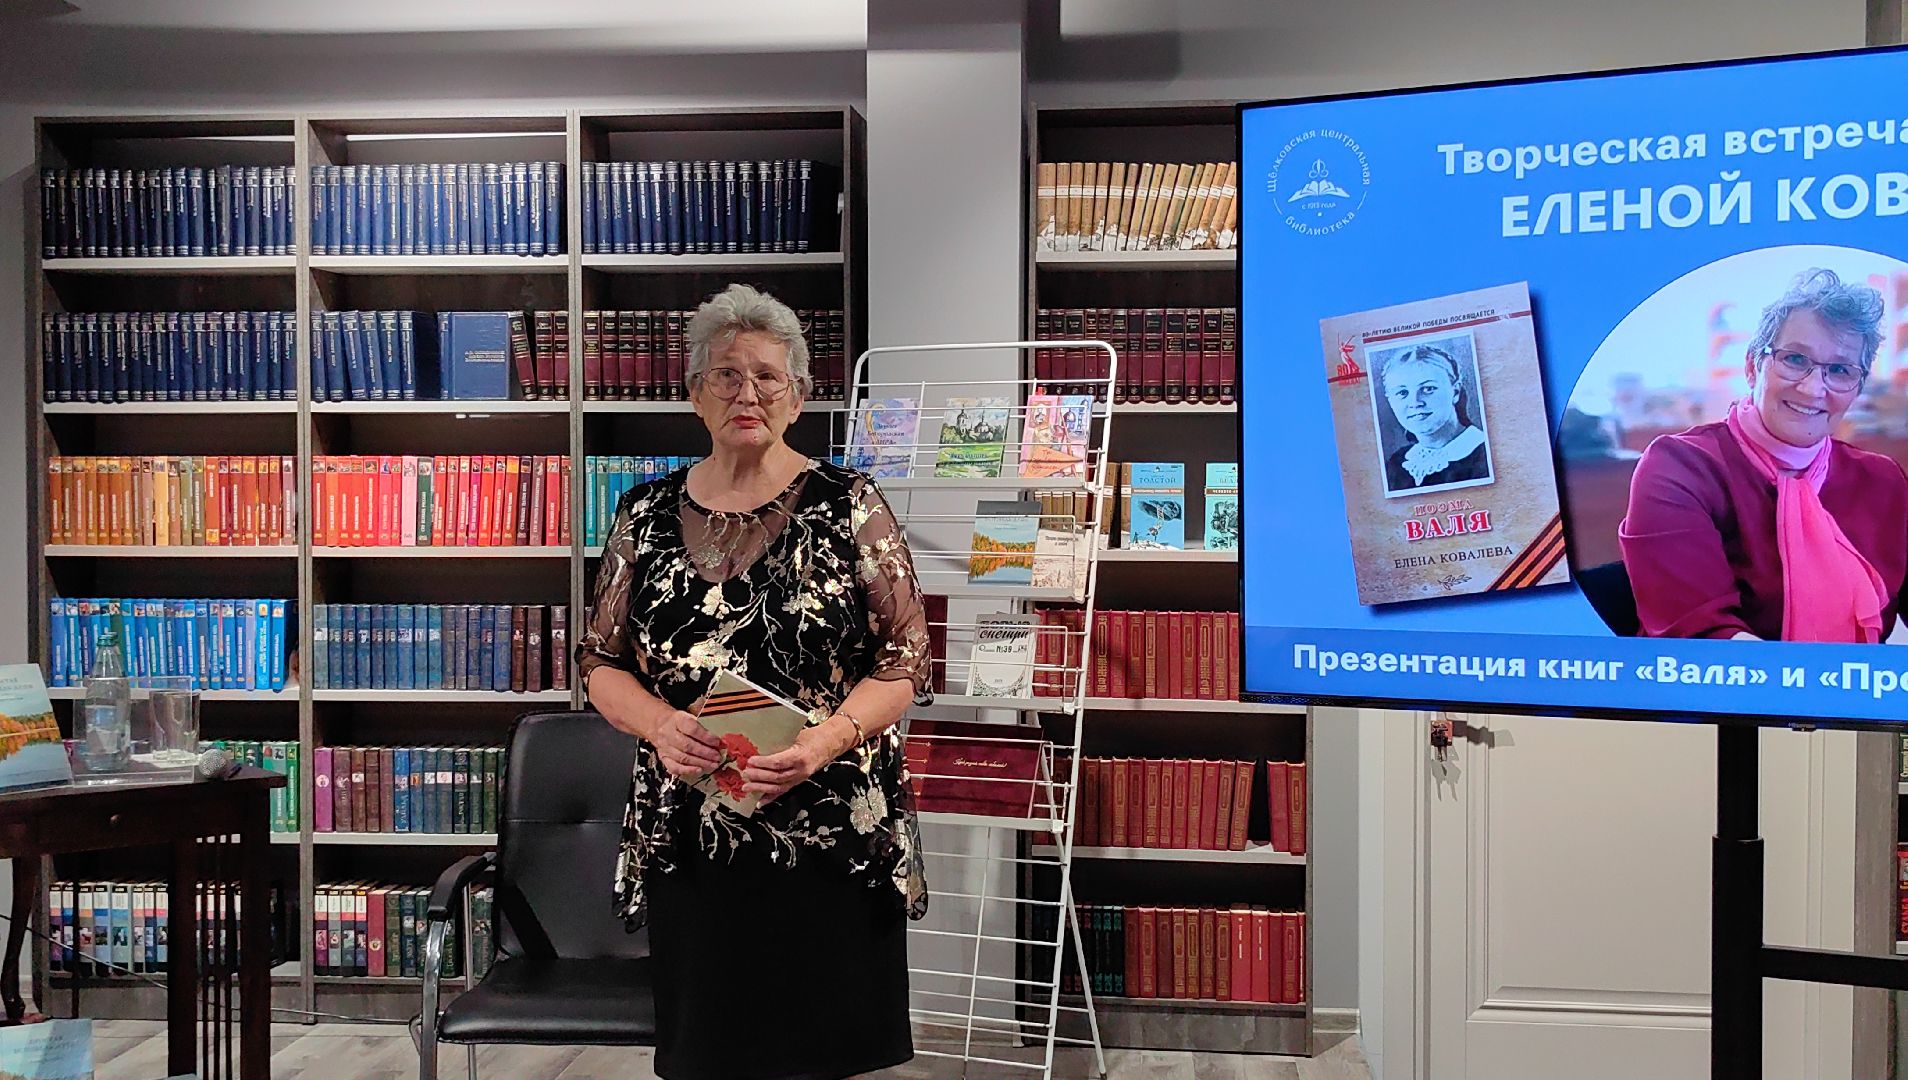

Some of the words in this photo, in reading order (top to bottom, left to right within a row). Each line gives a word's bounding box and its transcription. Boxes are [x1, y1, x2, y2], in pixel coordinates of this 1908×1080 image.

[1267, 129, 1316, 192] Щёлковская
[1321, 128, 1371, 185] центральная
[1438, 133, 1706, 178] Творческая
[1502, 171, 1752, 237] ЕЛЕНОЙ
[1777, 173, 1908, 222] КОВ
[1285, 211, 1355, 236] библиотека
[1393, 322, 1421, 333] ВЕЛИКОЙ
[1422, 317, 1448, 328] ПОБЕДЫ
[1450, 309, 1495, 323] ПОСВЯЩАЕТСЯ
[1414, 498, 1474, 516] ПОЭМА
[1404, 510, 1491, 541] ВАЛЯ
[1394, 556, 1436, 569] ЕЛЕНА
[1440, 545, 1513, 564] КОВАЛЕВА
[979, 629, 1029, 644] снегири
[1293, 643, 1526, 682] Презентация
[1538, 659, 1624, 682] книг
[1634, 656, 1767, 687] «Валя»
[1782, 668, 1805, 688] и
